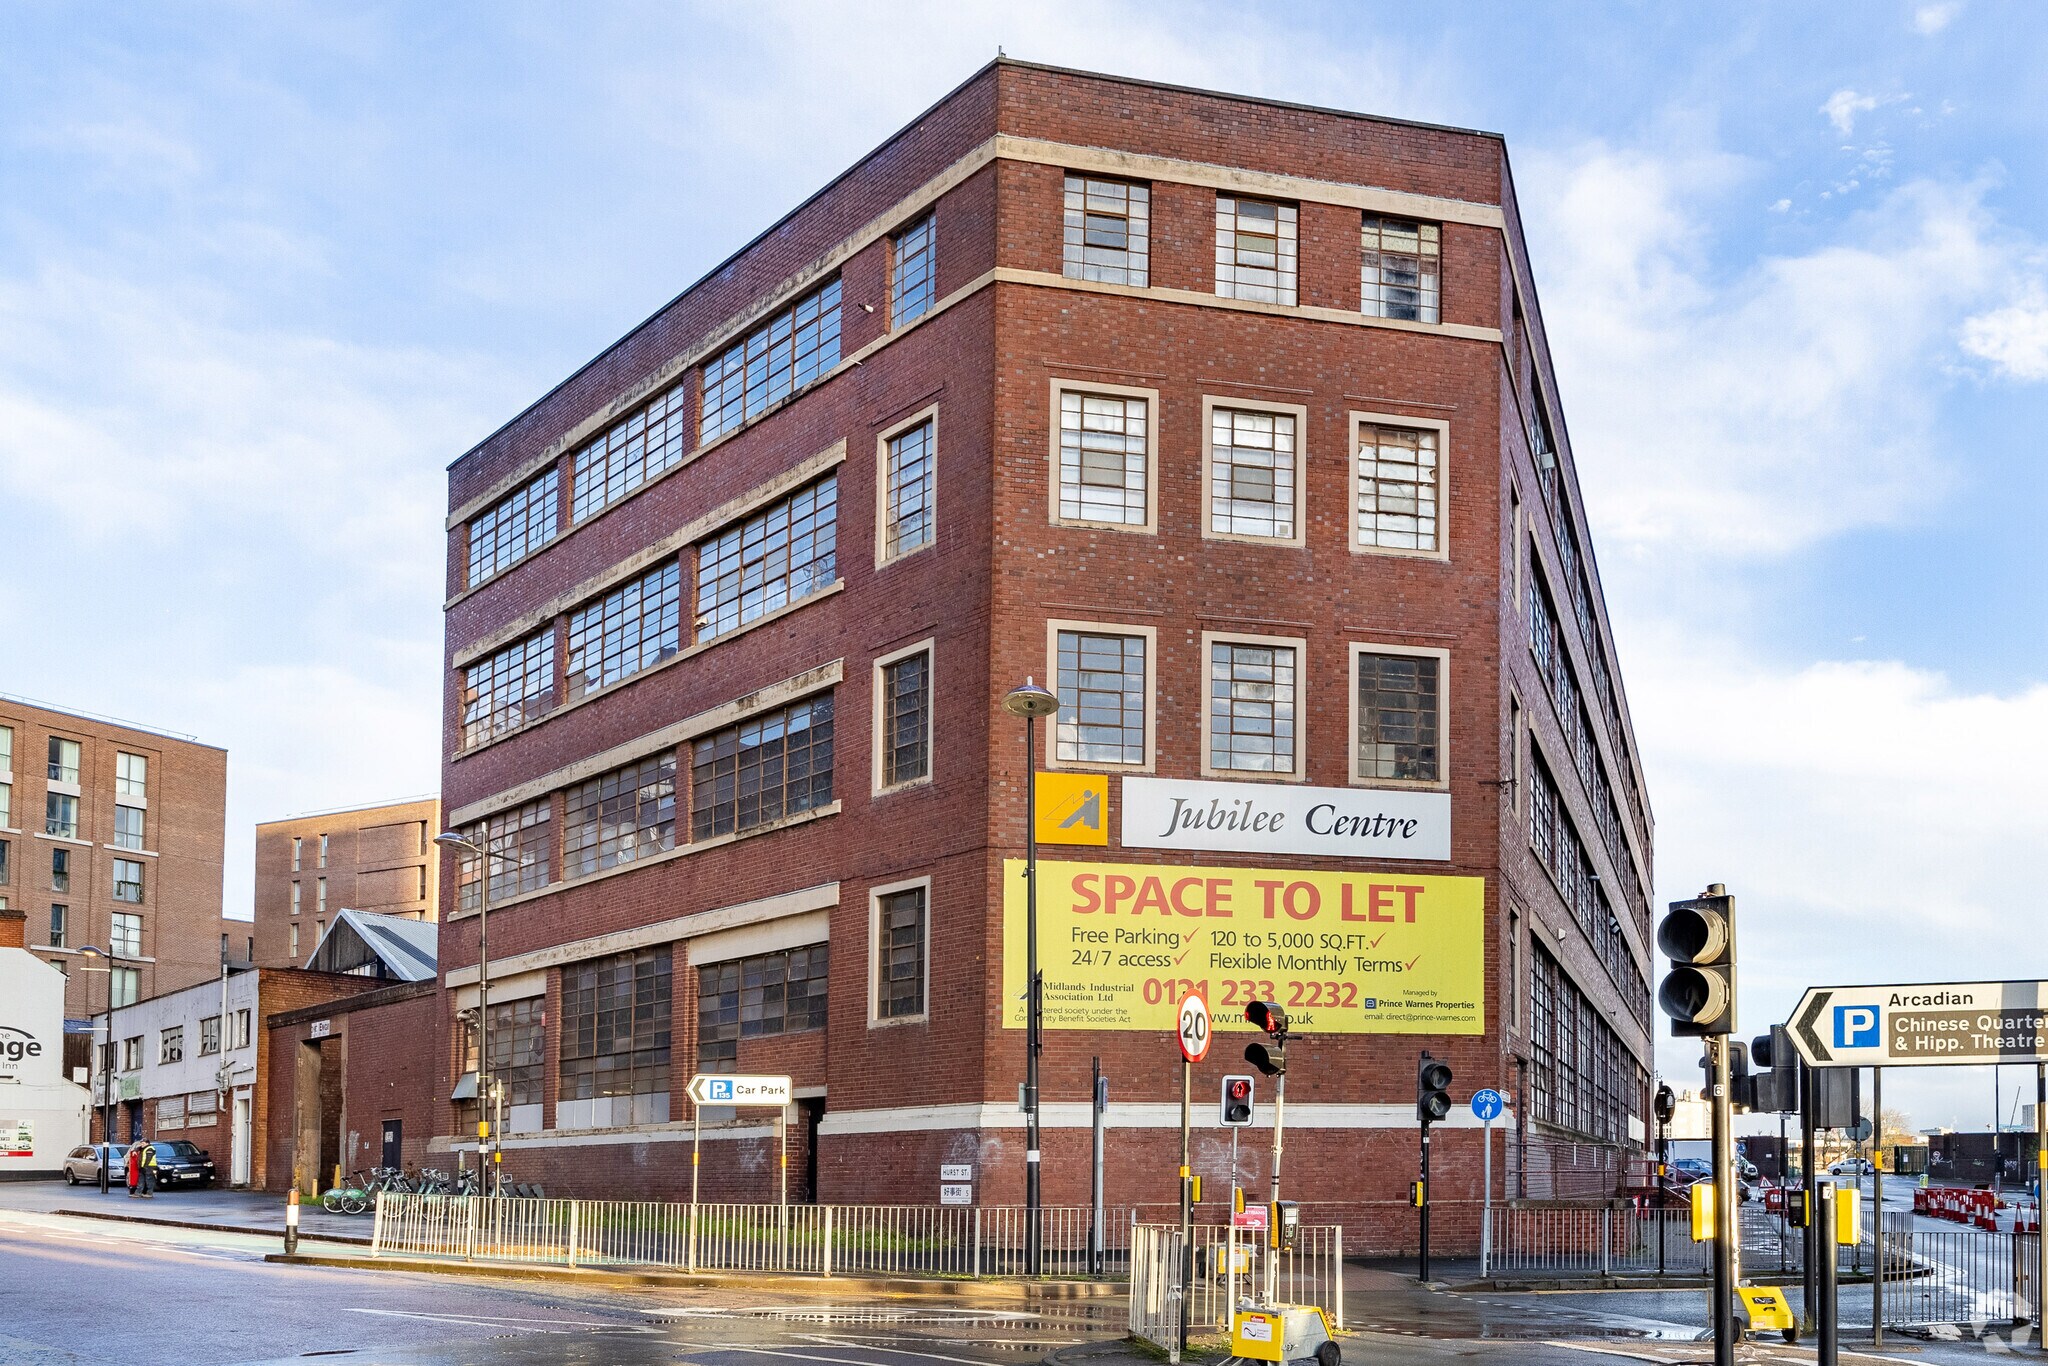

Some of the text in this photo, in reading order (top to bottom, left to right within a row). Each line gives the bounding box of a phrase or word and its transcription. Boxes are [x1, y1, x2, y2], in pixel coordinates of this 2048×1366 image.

[1158, 797, 1418, 839] Jubilee Centre
[1071, 873, 1425, 923] SPACE TO LET
[1071, 926, 1180, 950] Free Parking
[1210, 930, 1369, 951] 120 to 5,000 SQ.FT.
[1071, 949, 1171, 967] 24/7 access
[1209, 952, 1403, 976] Flexible Monthly Terms
[1043, 982, 1134, 992] Midlands Industrial
[1221, 980, 1275, 1007] 233
[1287, 981, 1358, 1009] 2232
[1402, 989, 1438, 997] Managed by
[1043, 992, 1114, 1002] Association Ltd
[1379, 999, 1475, 1010] Prince Warnes Properties
[1888, 992, 1974, 1007] Arcadian
[1058, 1014, 1084, 1023] Benefit
[1086, 1015, 1117, 1023] Societies
[1118, 1015, 1131, 1023] Act
[1064, 1006, 1090, 1015] society
[1091, 1006, 1112, 1014] under
[1115, 1007, 1128, 1015] the
[1364, 1012, 1476, 1022] email: direct@prince-warnes.com
[1182, 1010, 1206, 1041] 20
[1844, 1009, 1875, 1046] P
[1895, 1015, 1970, 1033] Chinese
[1895, 1032, 2045, 1053] & Hipp. Theatre
[712, 1081, 727, 1099] P
[736, 1085, 785, 1095] Car Park
[1714, 1085, 1722, 1096] 6
